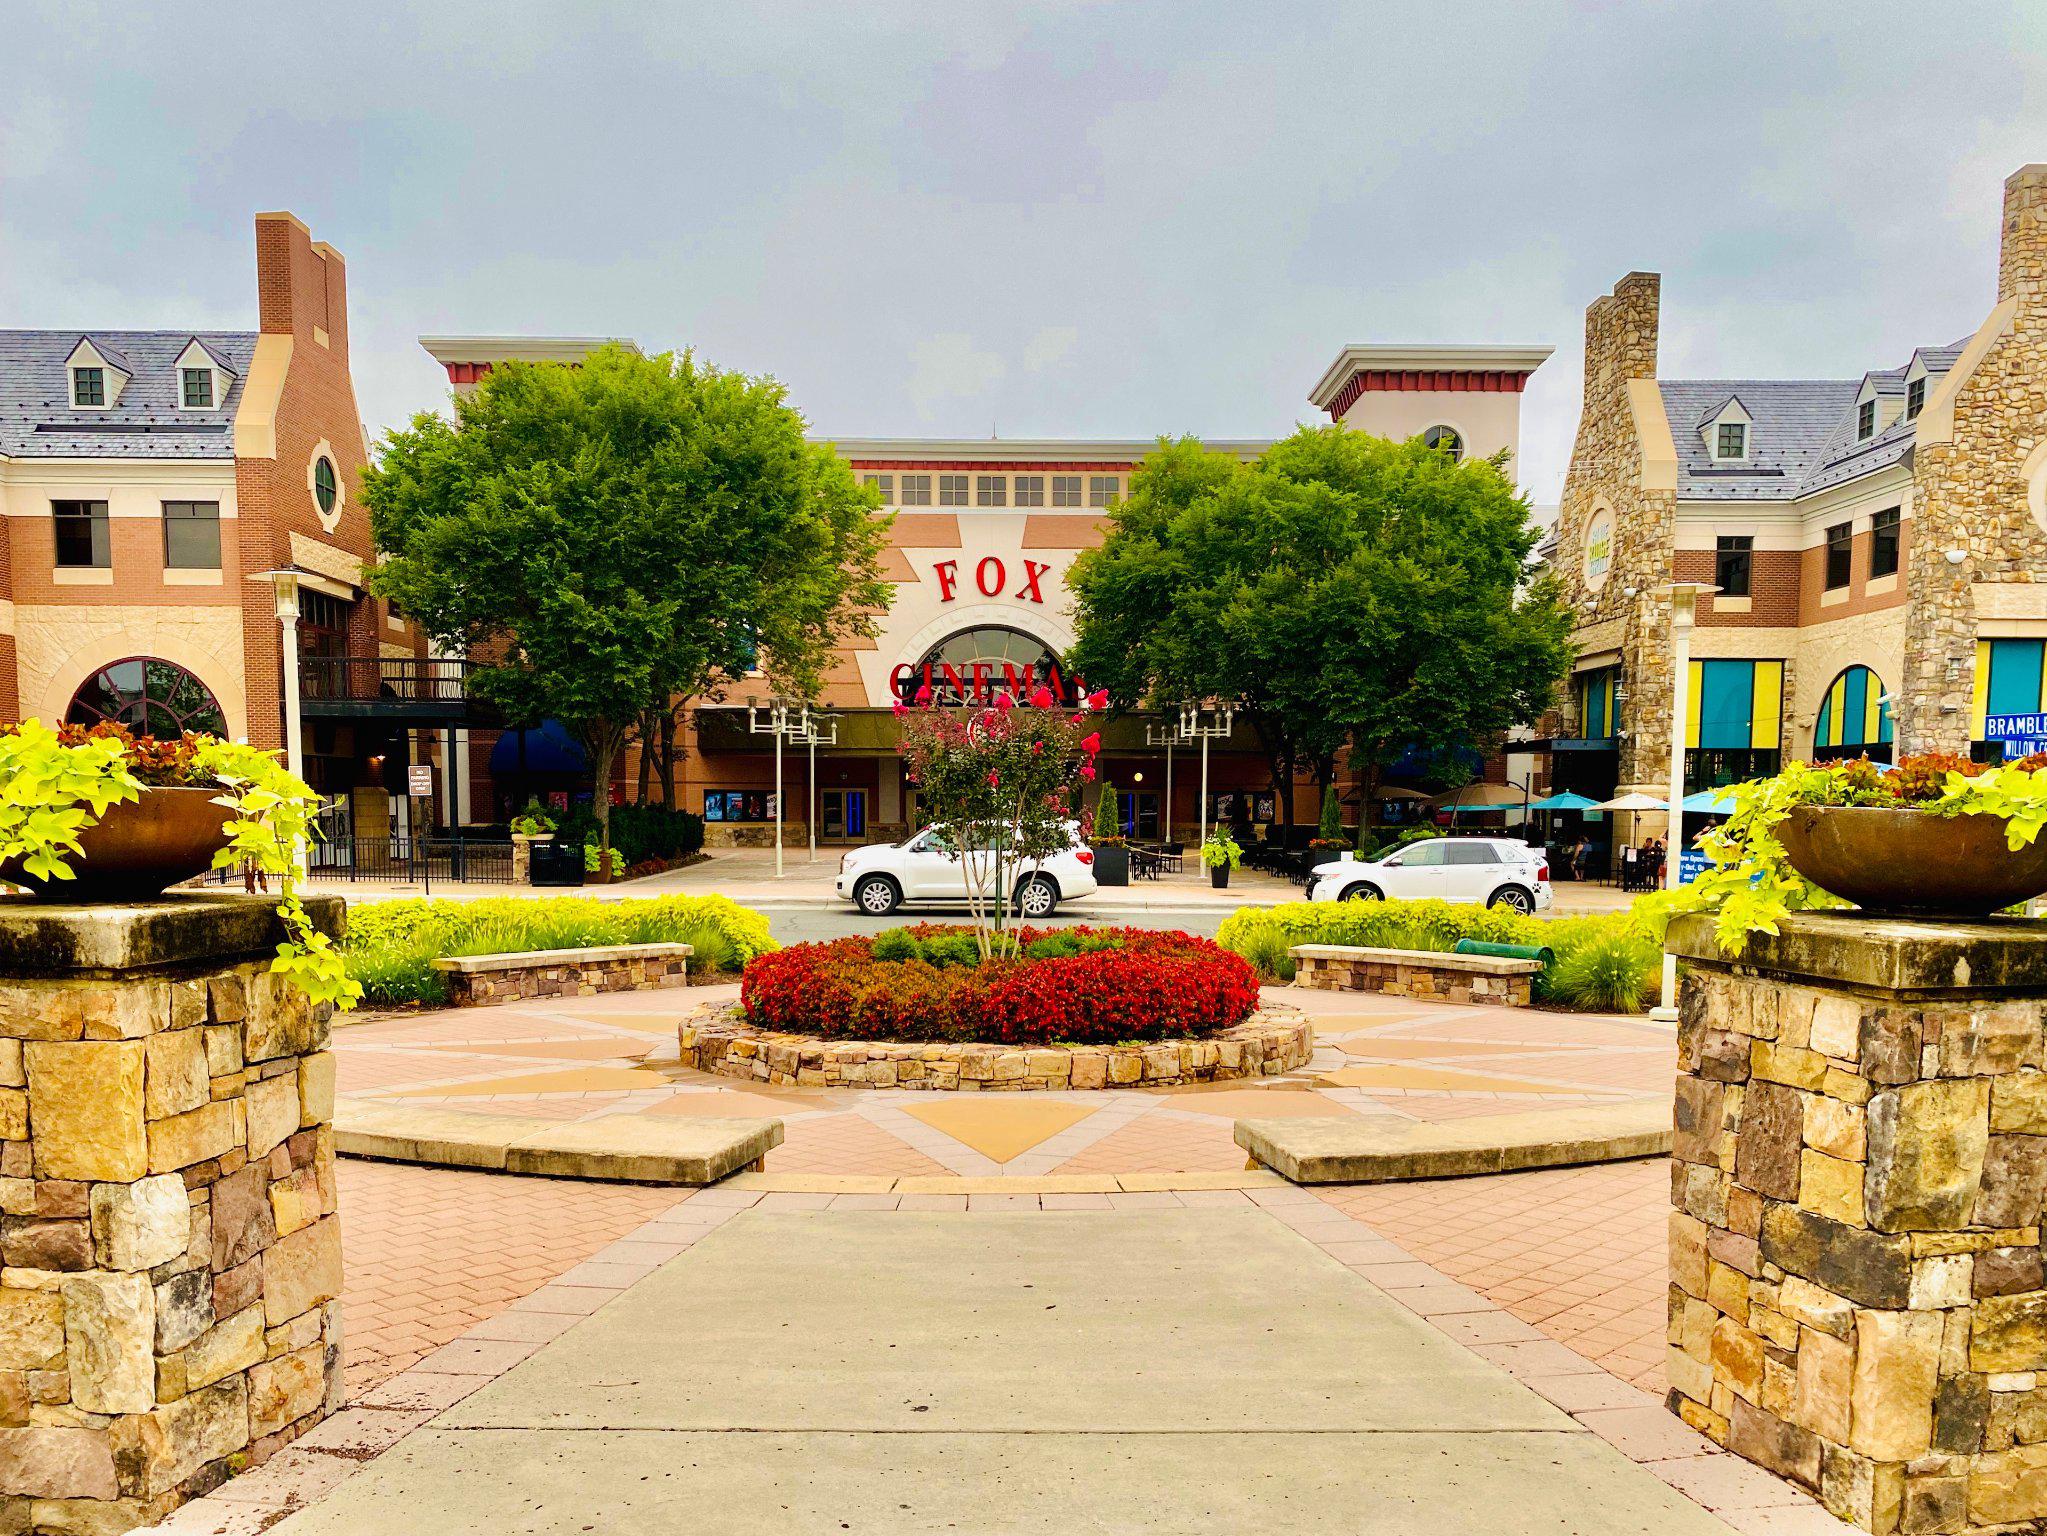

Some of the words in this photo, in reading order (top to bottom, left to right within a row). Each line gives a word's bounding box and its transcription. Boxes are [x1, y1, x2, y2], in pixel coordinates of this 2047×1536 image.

[932, 556, 1051, 604] FOX
[2005, 739, 2035, 758] WILLOW
[1690, 854, 1704, 864] Open
